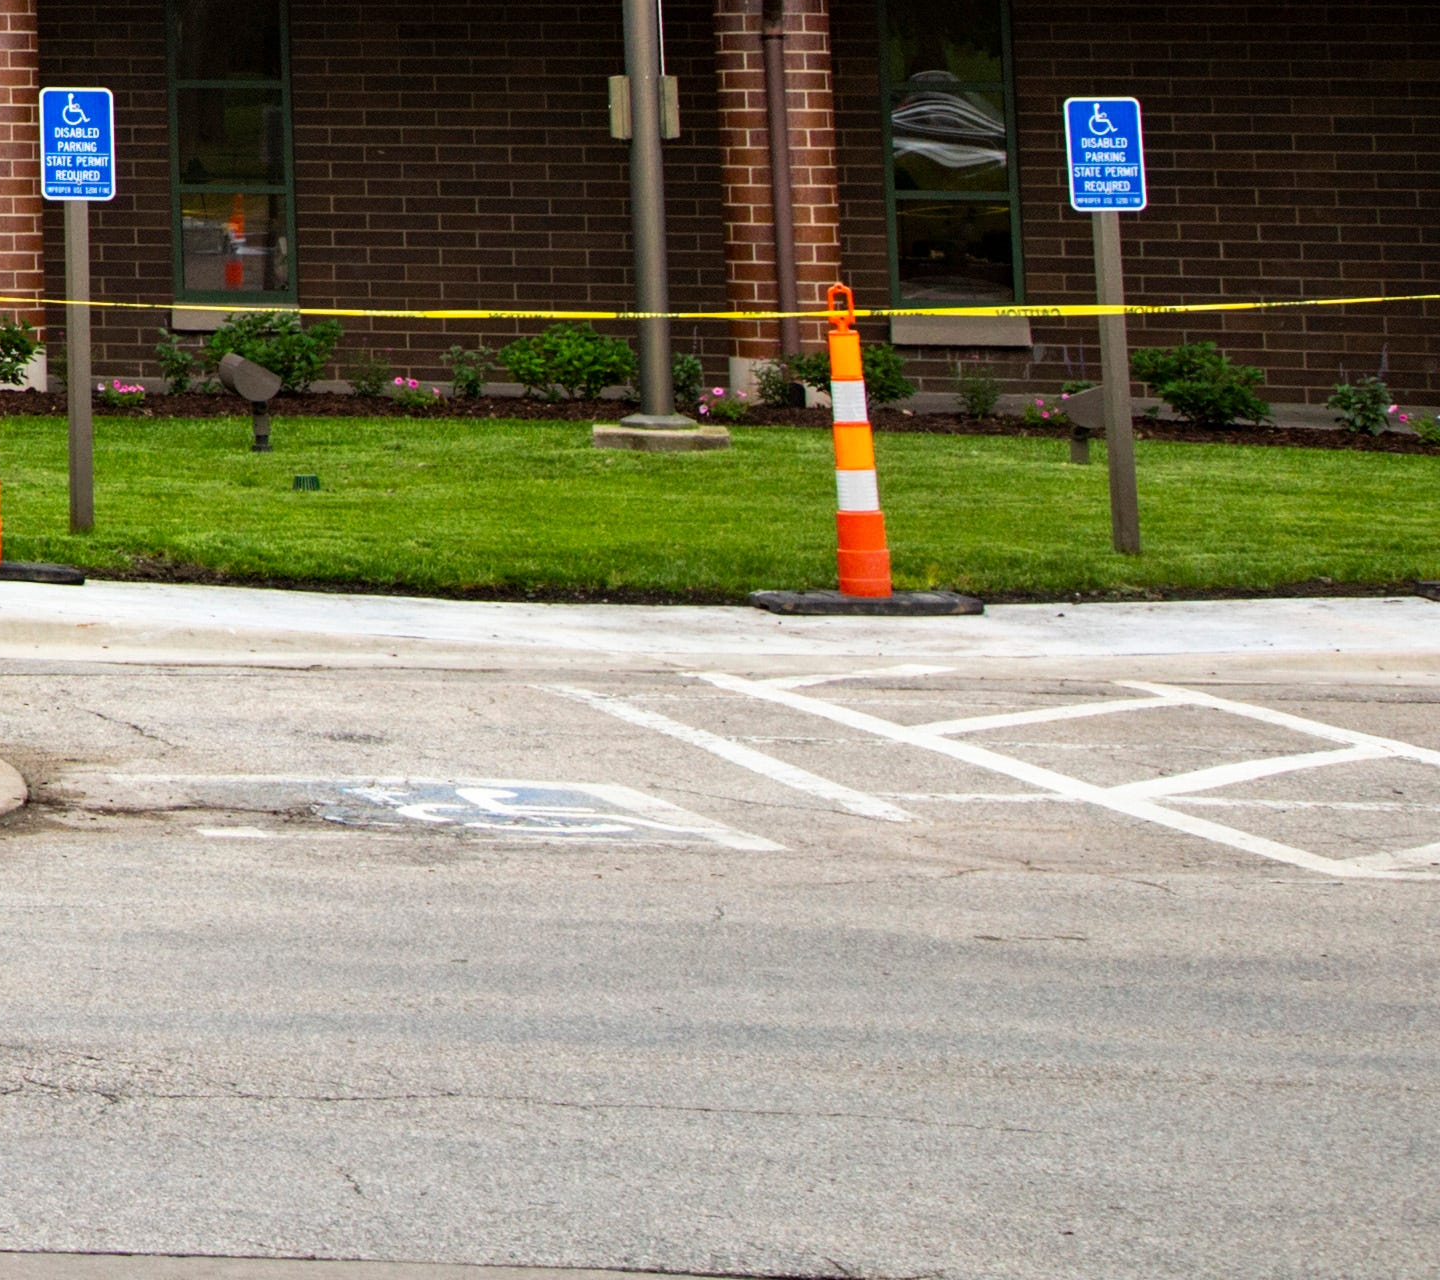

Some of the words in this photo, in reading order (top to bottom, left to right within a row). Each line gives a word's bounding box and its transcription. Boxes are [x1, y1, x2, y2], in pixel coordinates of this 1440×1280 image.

[54, 127, 100, 138] DISABLED
[57, 142, 97, 152] PARKING
[1081, 138, 1128, 148] DISABLED
[46, 156, 72, 167] STATE
[76, 157, 109, 167] PERMIT
[1085, 152, 1126, 162] PARKING
[55, 170, 100, 181] REQUIRED
[1074, 167, 1101, 177] STATE
[1105, 167, 1138, 177] PERMIT
[1084, 181, 1131, 192] REQUIRED
